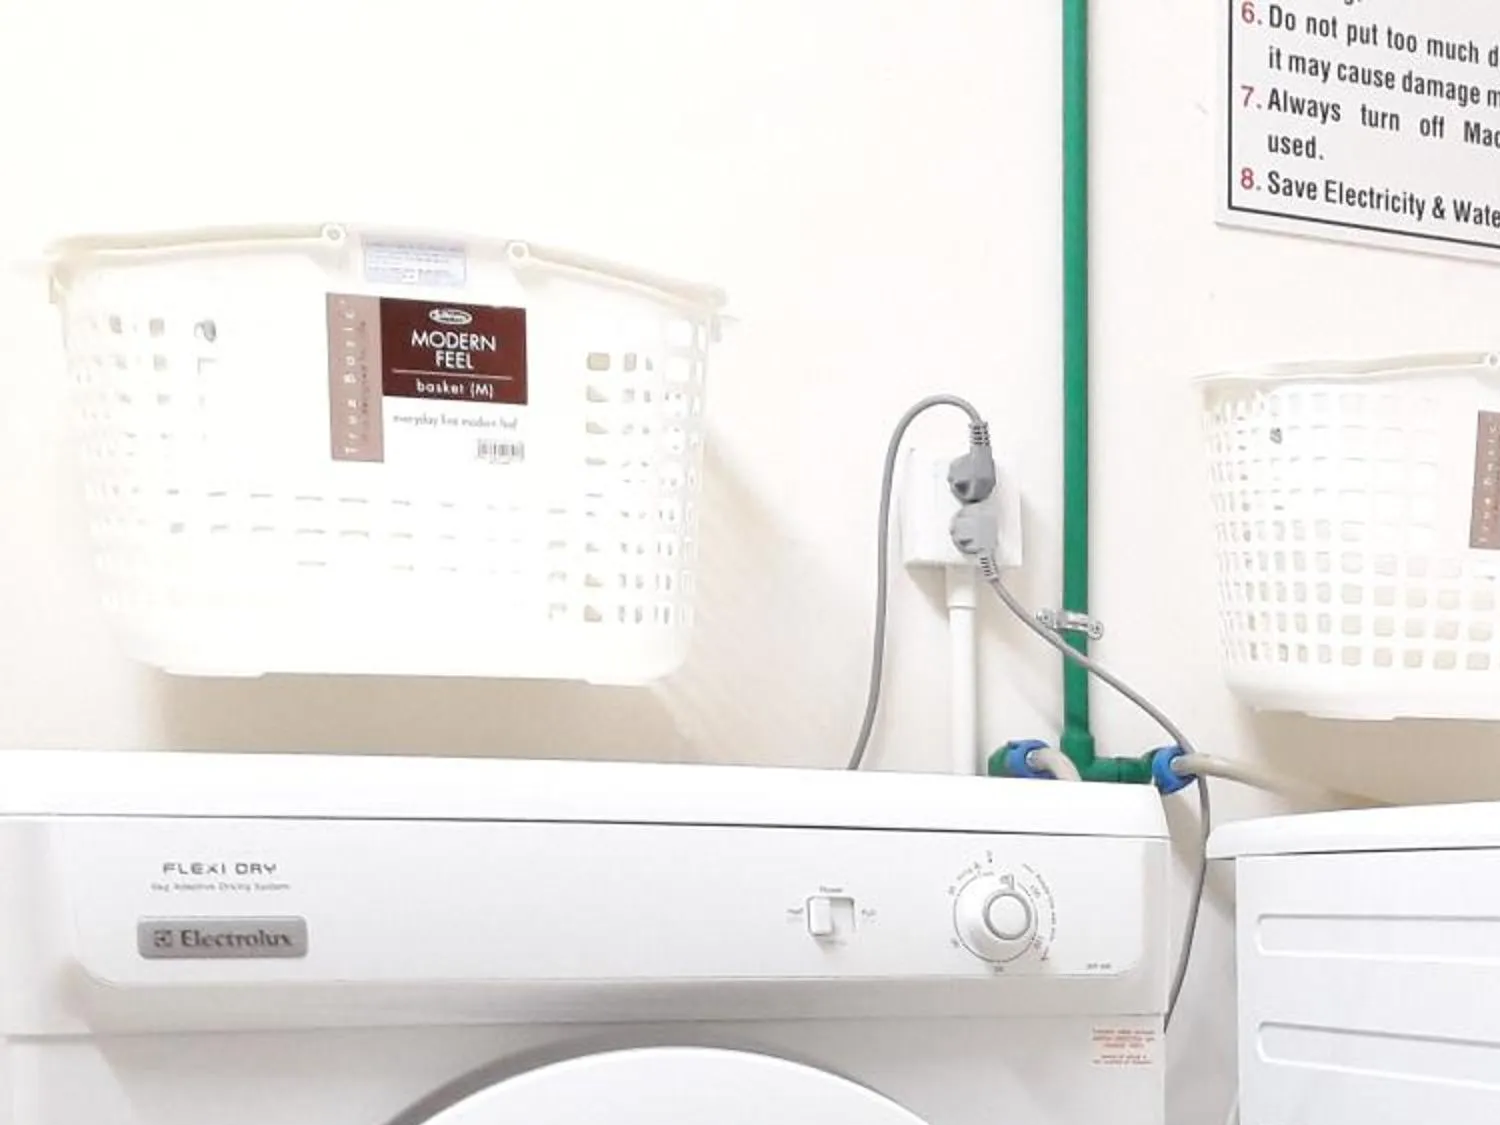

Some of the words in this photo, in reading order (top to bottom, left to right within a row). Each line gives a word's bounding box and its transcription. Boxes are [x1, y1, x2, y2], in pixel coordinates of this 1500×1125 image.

[1241, 1, 1263, 25] 6.
[1269, 4, 1297, 32] Do
[1305, 15, 1338, 40] not
[1346, 23, 1378, 47] put
[1386, 26, 1418, 54] too
[1426, 38, 1479, 65] much
[1268, 45, 1282, 71] it
[1288, 54, 1332, 84] may
[1337, 63, 1396, 91] cause
[1401, 69, 1481, 108] damage
[1240, 85, 1262, 109] 7.
[1267, 87, 1341, 125] Always
[1360, 103, 1400, 132] turn
[1419, 114, 1445, 139] off
[1267, 134, 1324, 161] used.
[1240, 167, 1262, 191] 8.
[1267, 170, 1318, 201] Save
[1324, 179, 1426, 222] Electricity
[1431, 195, 1446, 221] &
[411, 329, 497, 352] MODERN
[435, 351, 475, 370] FEEL
[416, 378, 464, 396] basket
[471, 382, 494, 399] (M)
[163, 862, 227, 876] FLEXI
[235, 862, 278, 875] DRY
[180, 929, 294, 948] Electrolux
